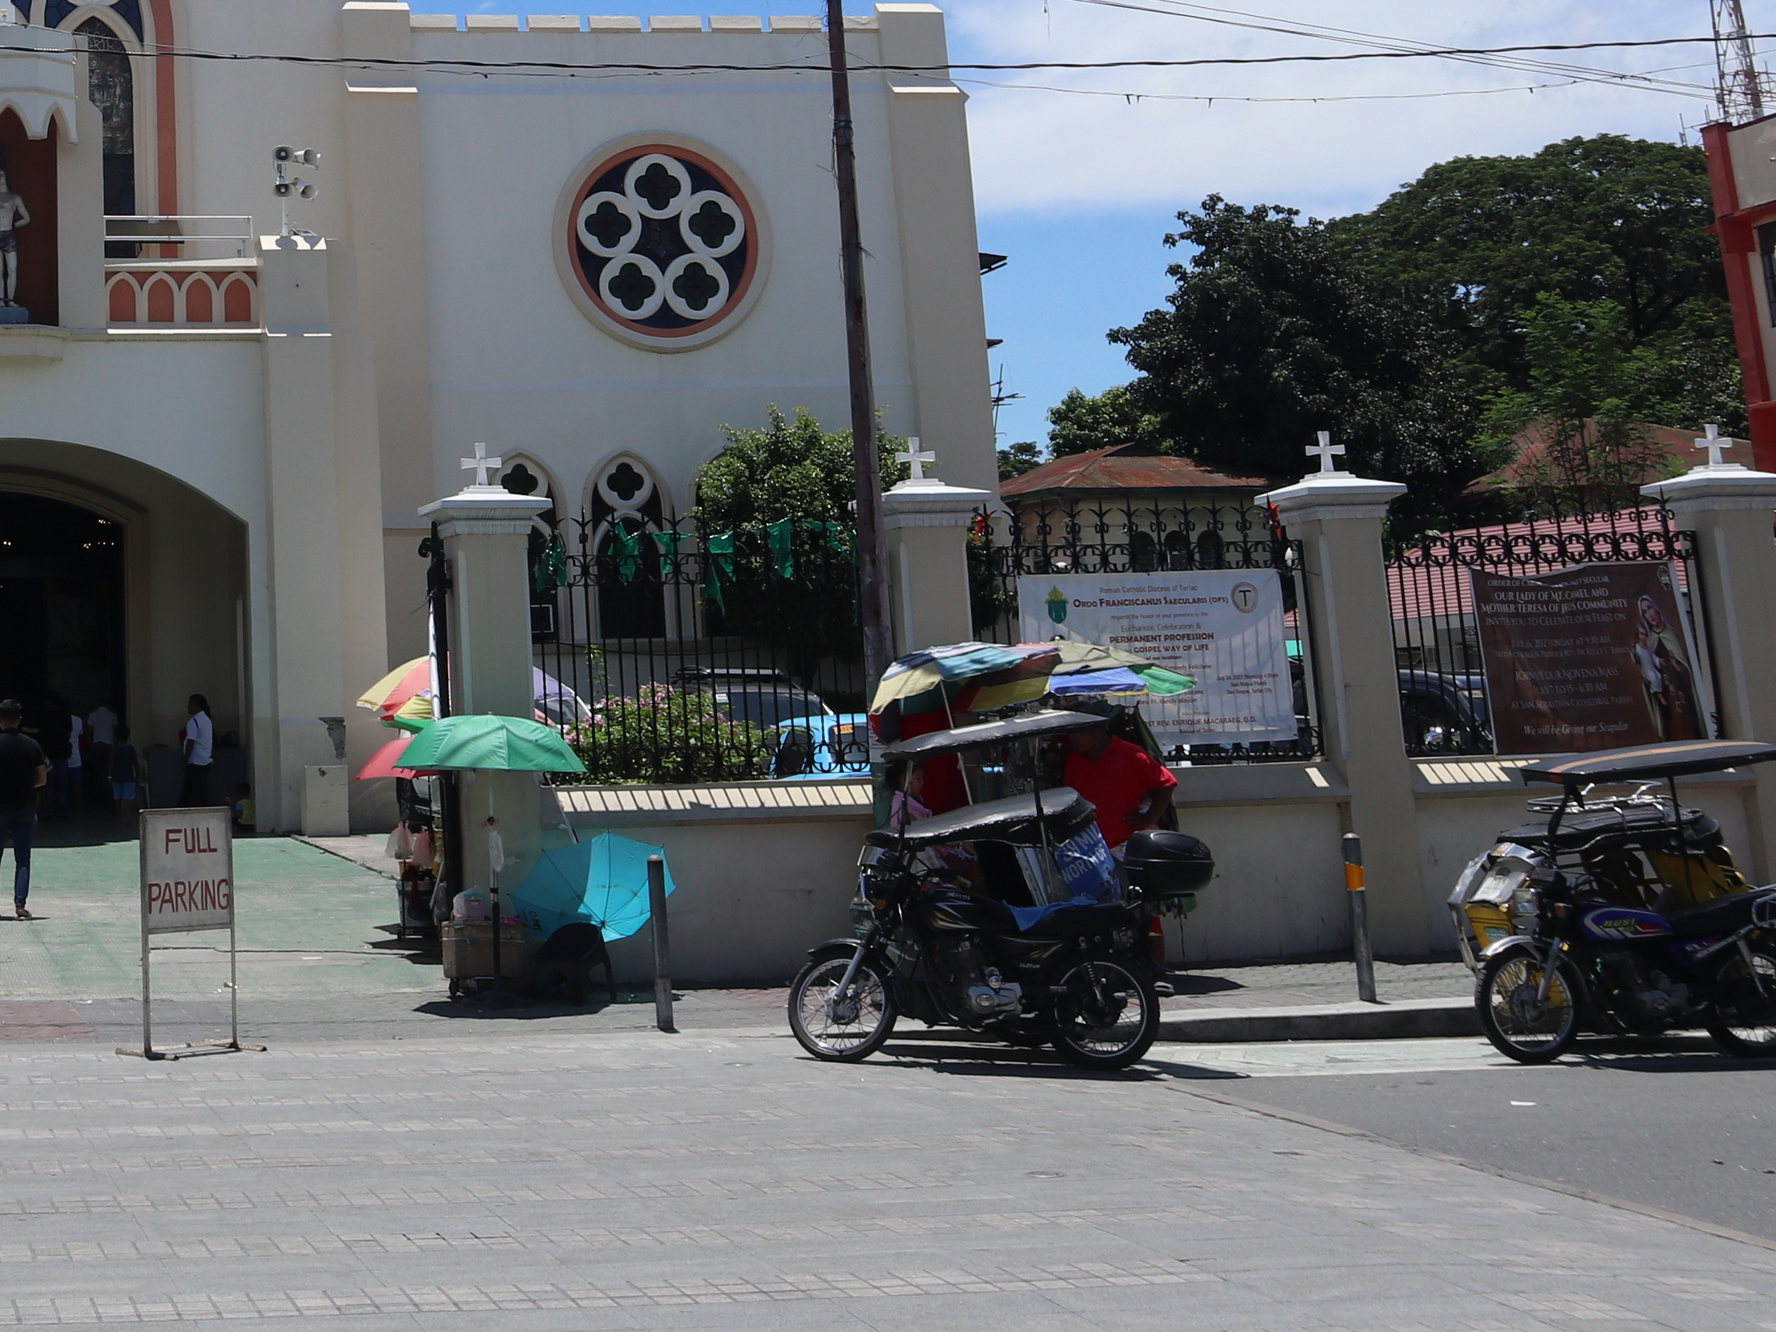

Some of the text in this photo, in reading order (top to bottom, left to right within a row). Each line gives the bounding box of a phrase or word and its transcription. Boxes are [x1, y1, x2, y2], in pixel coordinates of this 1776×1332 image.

[1582, 575, 1610, 584] SECULAR
[1099, 583, 1198, 594] Roman Catholic Diocese of Tarlac
[1494, 591, 1515, 601] OUR
[1516, 591, 1536, 603] LADY
[1537, 590, 1550, 600] OF
[1550, 590, 1565, 602] MT.
[1591, 587, 1609, 597] AND
[1480, 602, 1516, 614] MOTHER
[1517, 603, 1547, 613] TERESA
[1548, 602, 1560, 612] OF
[1577, 598, 1628, 611] COMMUNITY
[1510, 616, 1527, 626] YOU
[1527, 616, 1538, 626] TO
[1574, 614, 1592, 624] OUR
[1592, 612, 1613, 622] FEAST
[1613, 612, 1626, 621] ON
[1120, 624, 1155, 632] Eucharistic
[1156, 623, 1194, 631] Celebration
[1109, 632, 1214, 644] PERMANENT PROFESSION
[1575, 637, 1584, 645] AT
[1599, 635, 1611, 644] AM
[1194, 643, 1209, 651] LIFE
[1561, 668, 1598, 680] NOVENA
[1597, 666, 1620, 677] MASS
[1555, 684, 1566, 694] TO
[1594, 682, 1608, 692] AM
[1520, 699, 1535, 709] SAN
[1172, 718, 1202, 726] ENRIQUE
[1203, 716, 1242, 725] MACARAEG,
[1244, 715, 1257, 723] D.D.
[1524, 724, 1536, 735] We
[1537, 724, 1550, 734] will
[1561, 723, 1585, 735] Giving
[165, 827, 218, 855] FULL
[147, 878, 230, 915] PARKING
[1603, 918, 1636, 928] RUSI
